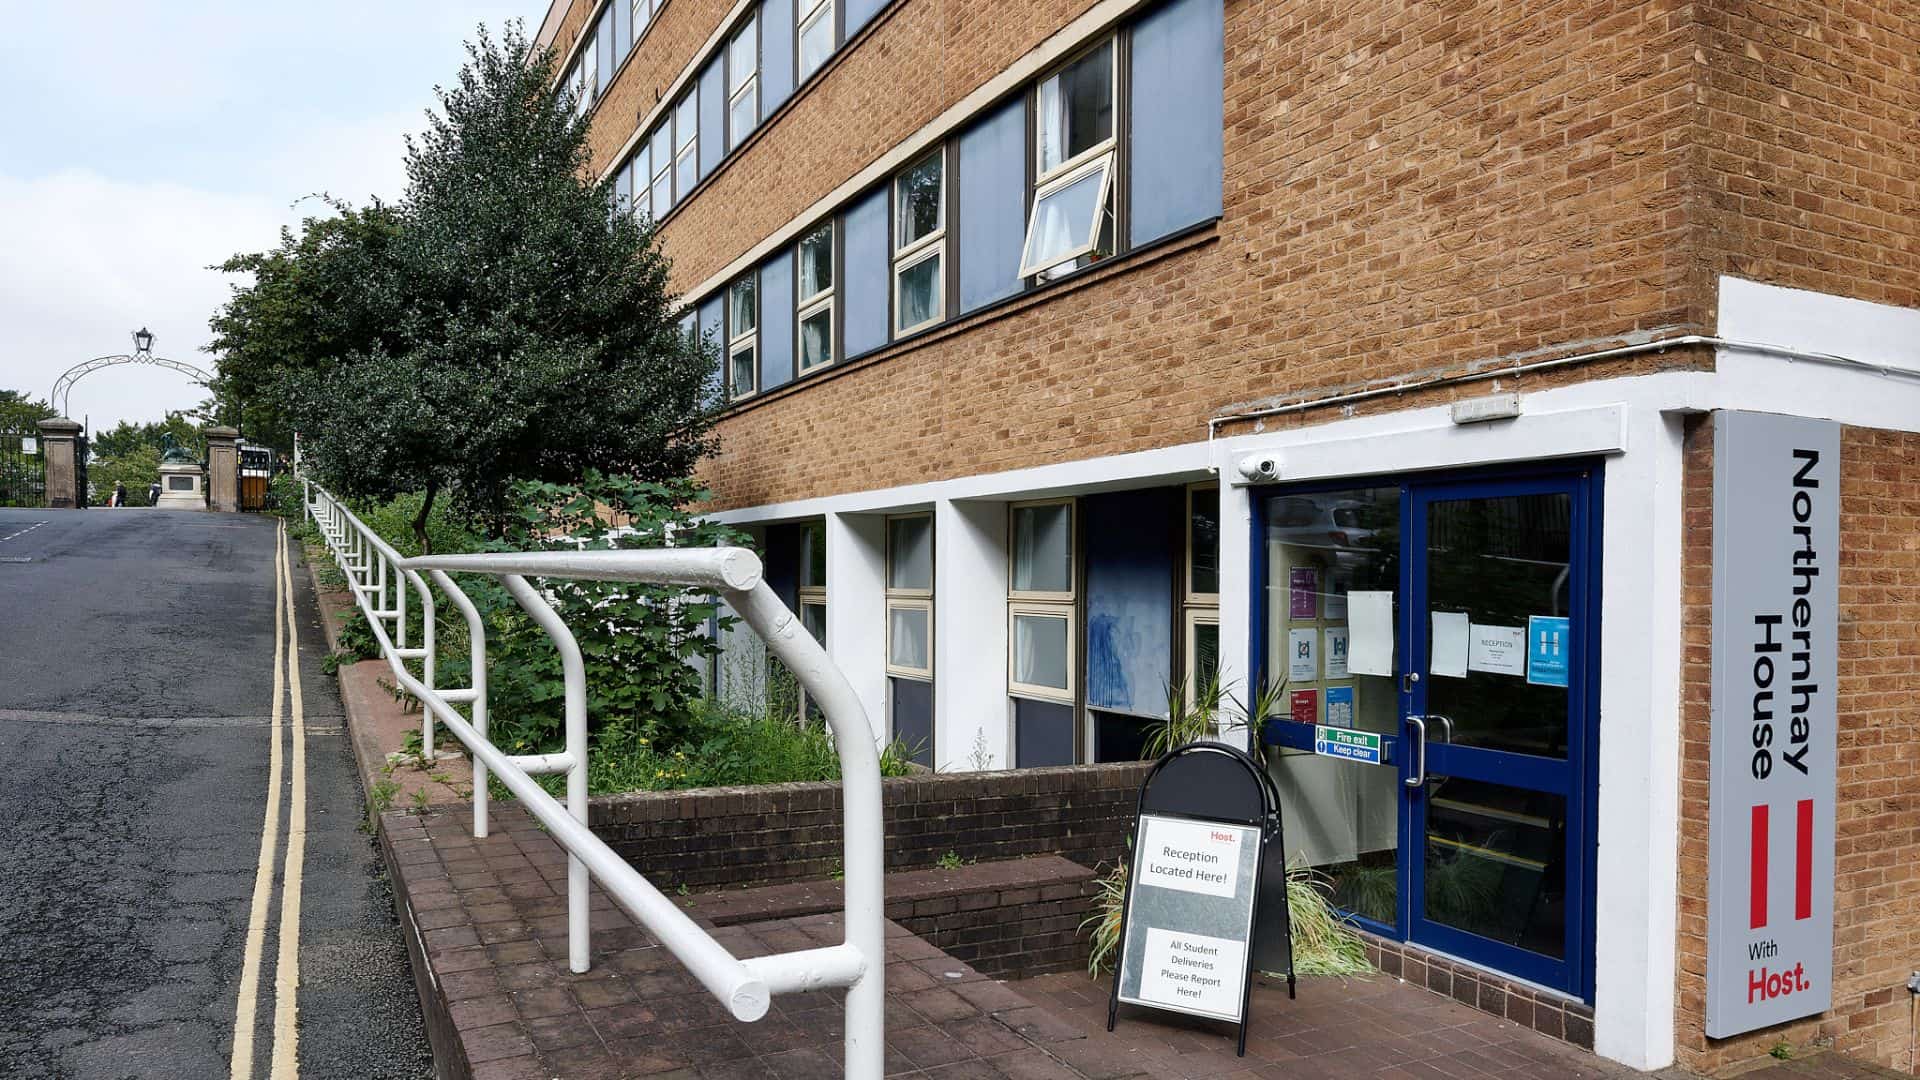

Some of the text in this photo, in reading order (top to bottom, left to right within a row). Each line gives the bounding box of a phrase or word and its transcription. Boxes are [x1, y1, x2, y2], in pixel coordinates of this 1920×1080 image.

[1783, 449, 1819, 775] Northernhay
[1481, 639, 1513, 649] RECEPTION
[1752, 614, 1783, 780] House
[1336, 732, 1368, 745] Fire exit
[1333, 743, 1371, 758] Keep clear
[1210, 830, 1236, 842] Host.
[1163, 846, 1219, 864] Reception
[1150, 863, 1228, 884] Located Here!
[1170, 940, 1218, 956] All Student
[1748, 939, 1778, 960] With
[1171, 955, 1214, 970] Deliveries
[1161, 969, 1221, 988] Please Report
[1748, 962, 1810, 1004] Host.
[1176, 985, 1202, 999] Here!
